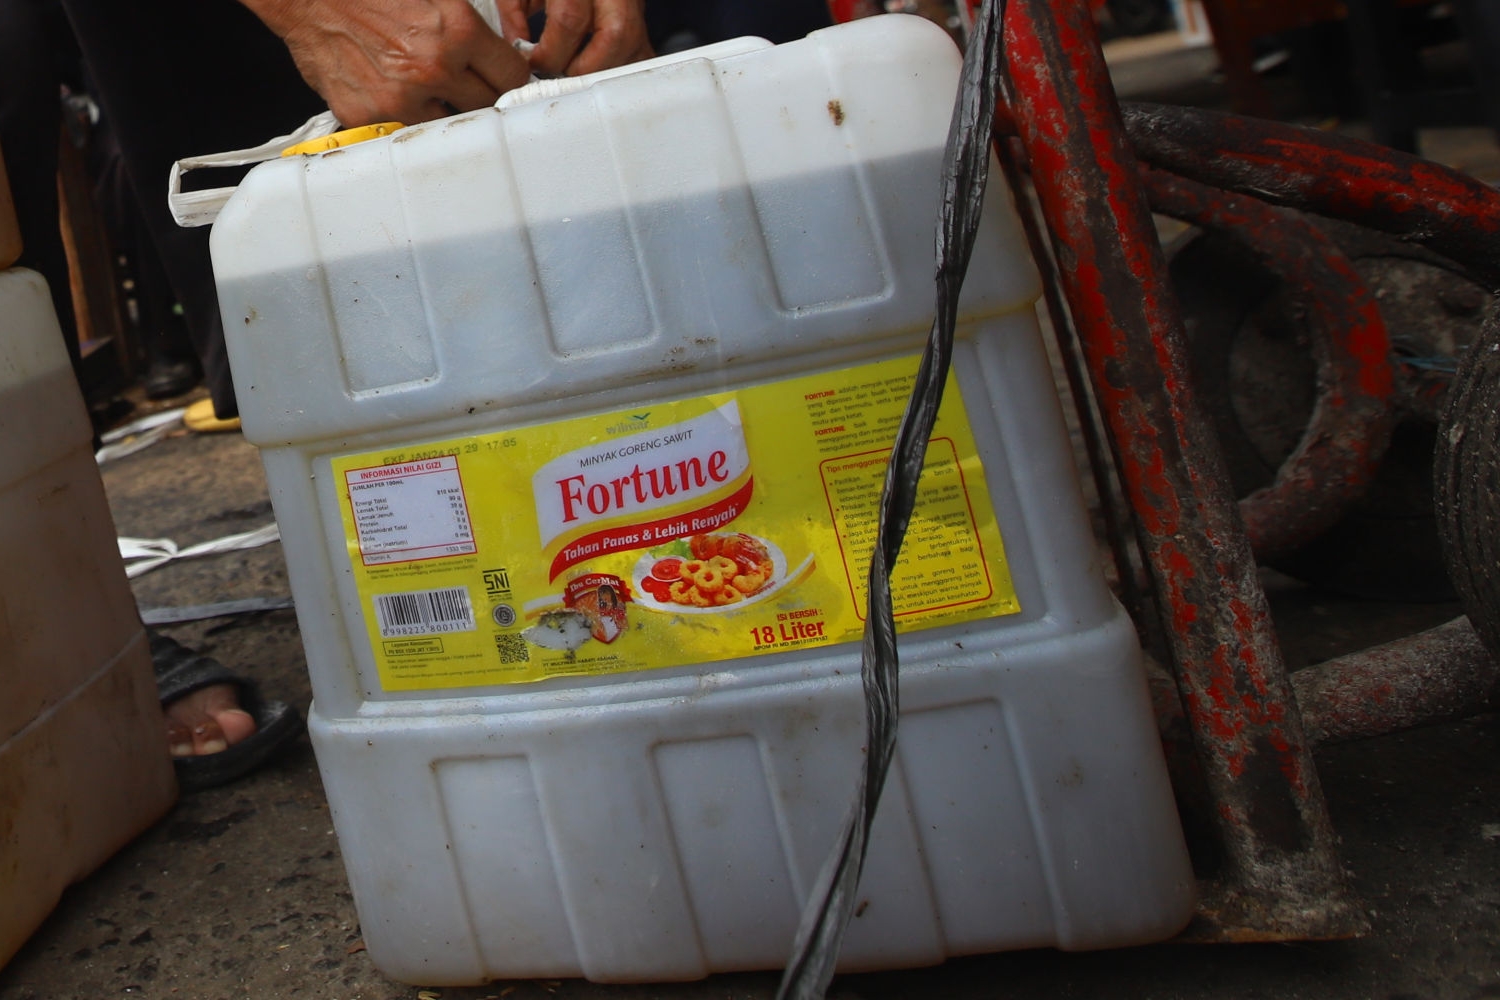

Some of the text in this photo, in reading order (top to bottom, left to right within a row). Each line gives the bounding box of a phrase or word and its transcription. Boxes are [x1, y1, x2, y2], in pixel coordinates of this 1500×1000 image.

[580, 429, 694, 469] MINYAK GORENG SAWIT
[360, 461, 442, 480] INFORMASI NILAI GIZI
[556, 450, 729, 523] Fortune
[564, 505, 738, 561] Tahan Panas & Lebih Renyah
[483, 571, 510, 591] SNI
[570, 576, 620, 592] Ibu CerMat
[776, 613, 788, 622] ISI
[789, 608, 818, 620] BERSIH
[750, 620, 825, 645] 18 Liter
